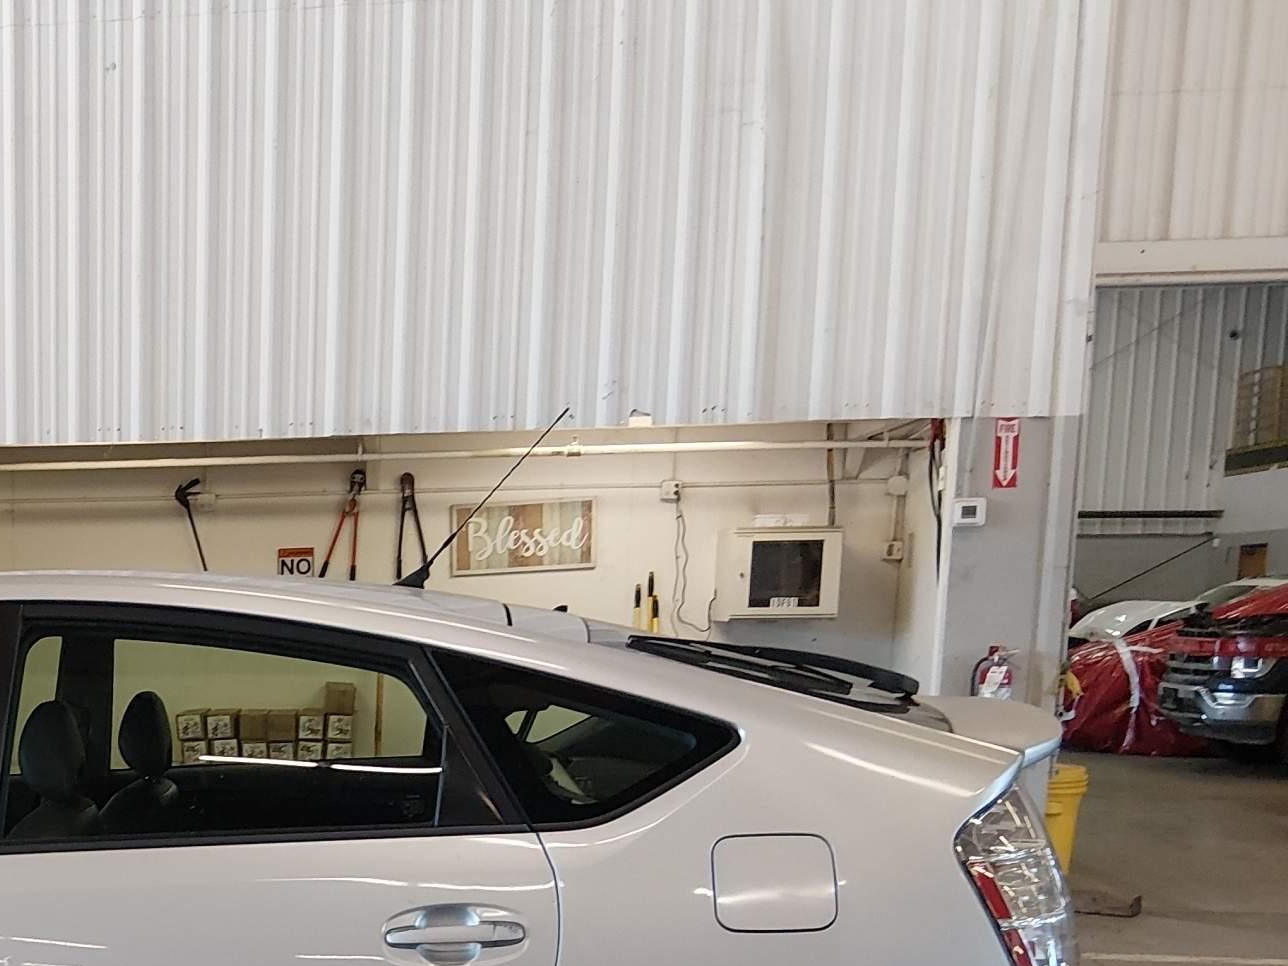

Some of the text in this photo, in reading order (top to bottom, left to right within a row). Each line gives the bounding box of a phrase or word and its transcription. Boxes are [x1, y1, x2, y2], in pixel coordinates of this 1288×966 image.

[999, 423, 1016, 433] FIRE
[467, 515, 589, 561] Blessed
[280, 558, 311, 575] NO
